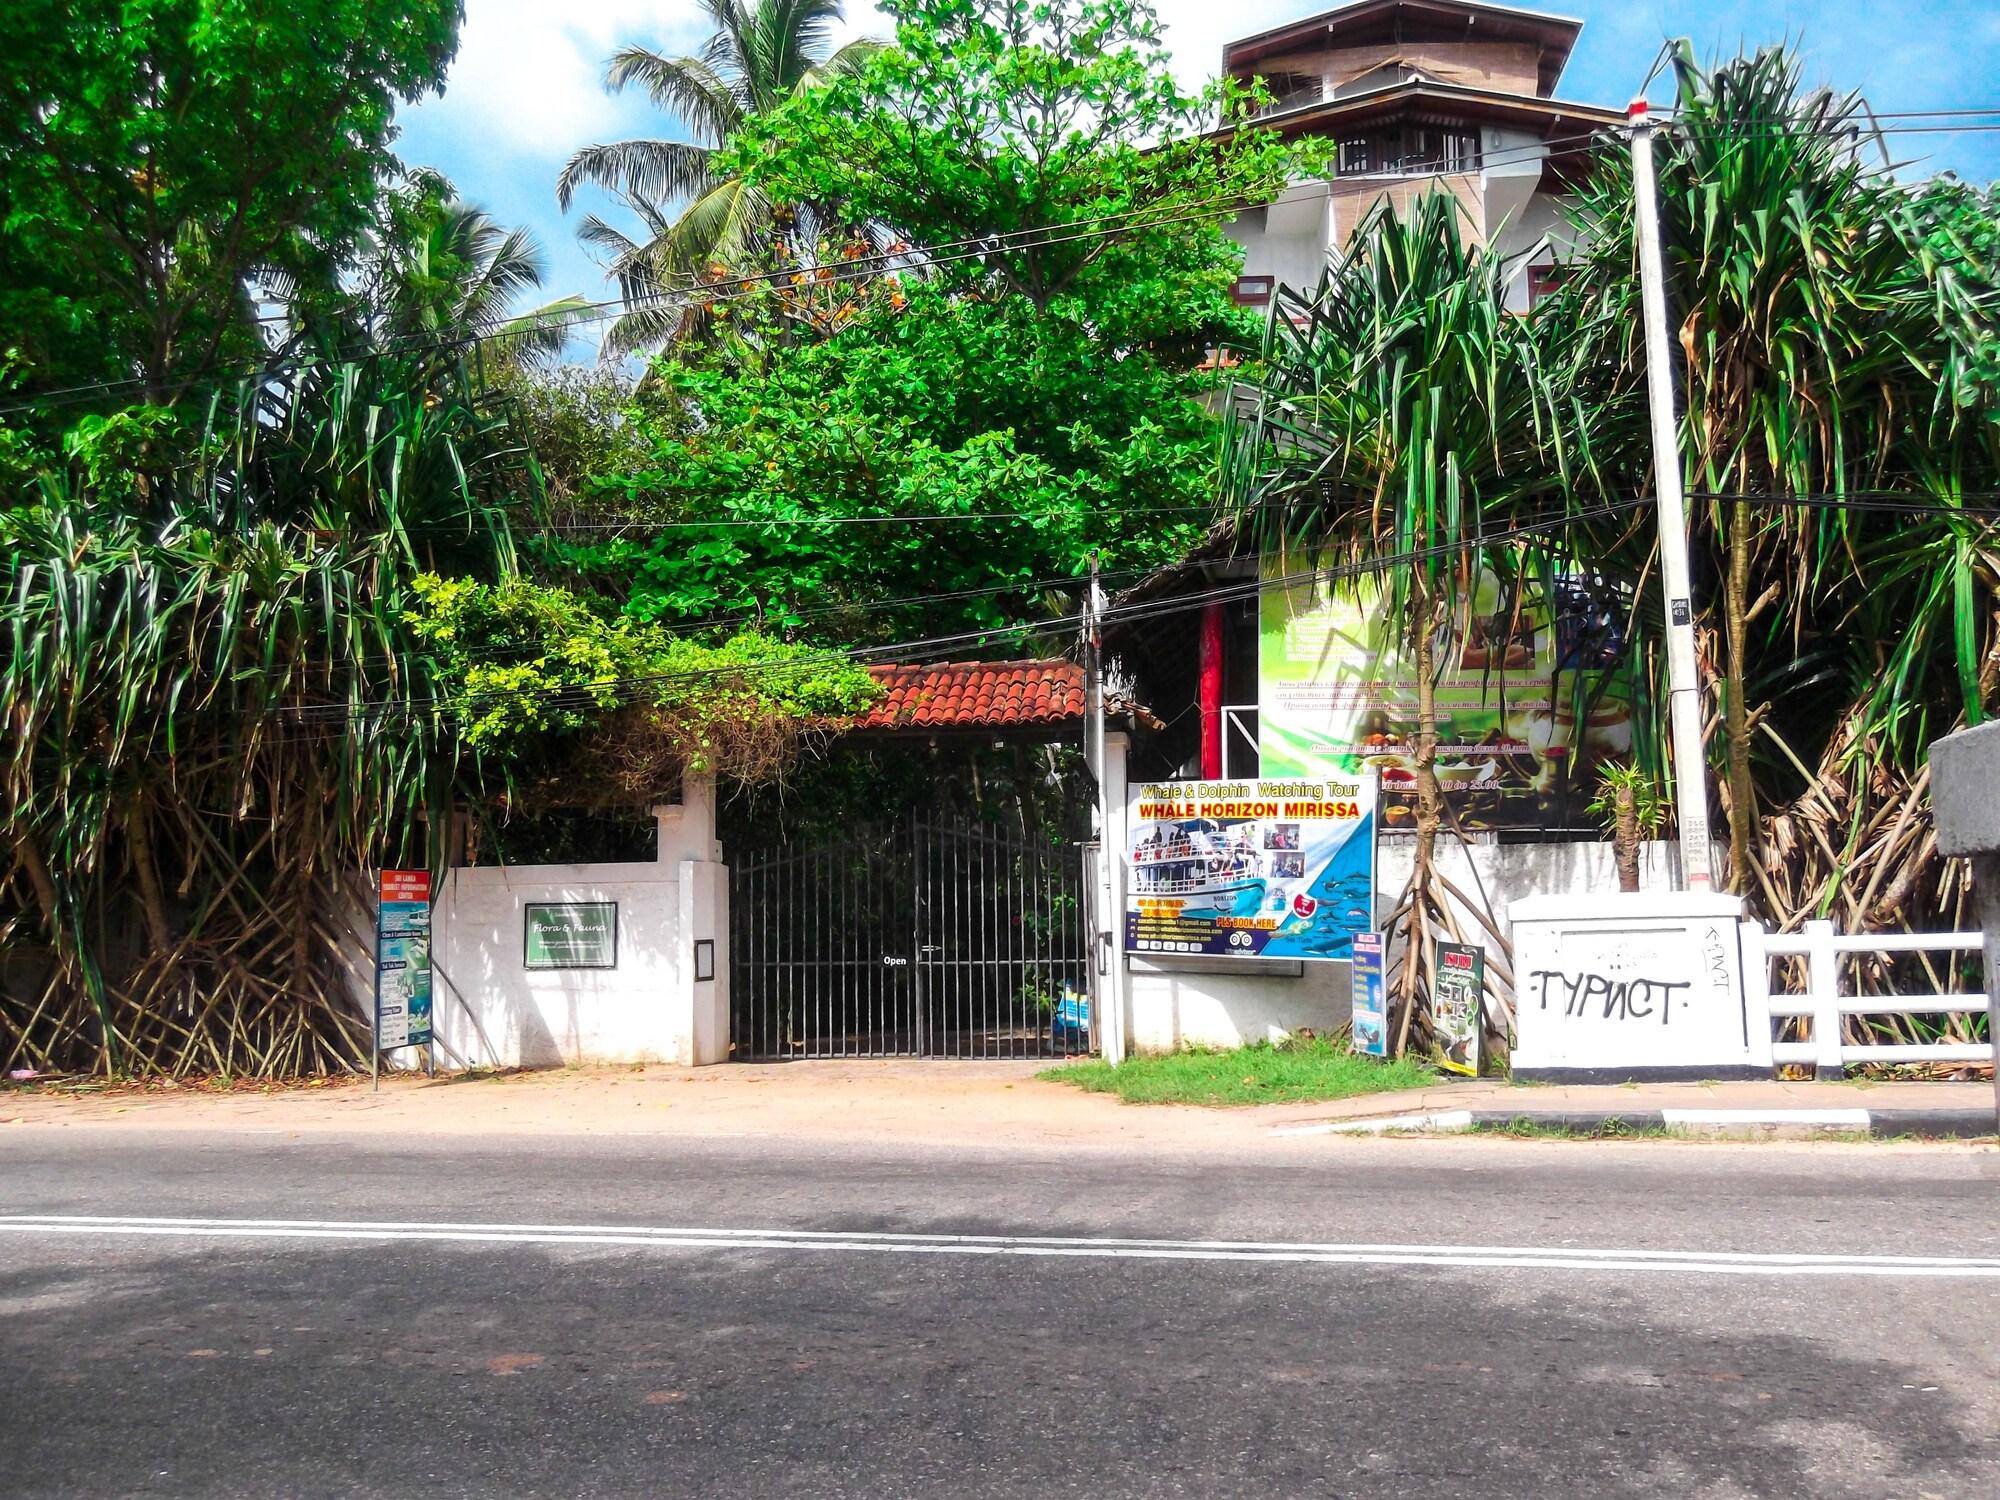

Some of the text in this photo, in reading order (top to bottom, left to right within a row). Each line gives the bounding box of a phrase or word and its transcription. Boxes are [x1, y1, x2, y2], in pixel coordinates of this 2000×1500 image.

[1142, 781, 1359, 801] Whale & Dolphin Watching Tour
[1139, 802, 1360, 818] WHALE HORIZON MIRISSA
[533, 923, 561, 933] Flora
[573, 923, 607, 933] Fauna
[1216, 917, 1232, 927] PLS
[1232, 917, 1254, 928] BOOK
[1256, 918, 1276, 929] HERE
[884, 956, 906, 967] Open
